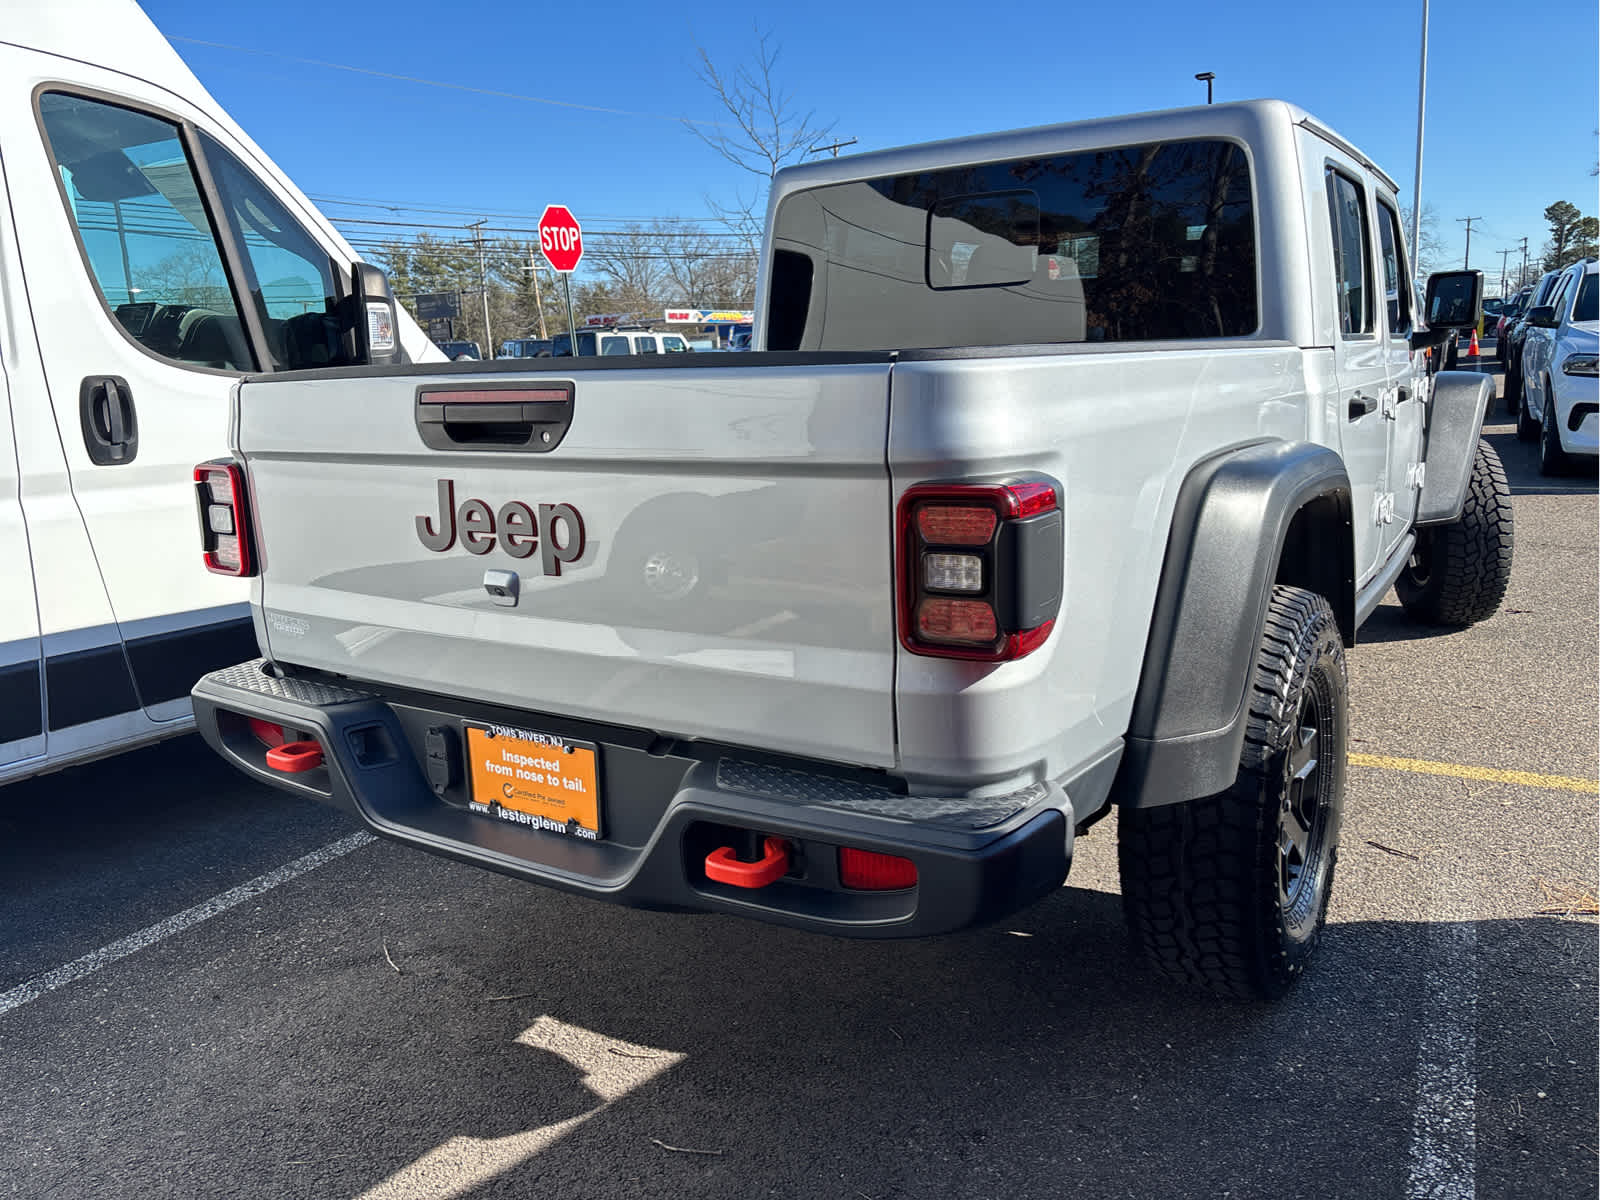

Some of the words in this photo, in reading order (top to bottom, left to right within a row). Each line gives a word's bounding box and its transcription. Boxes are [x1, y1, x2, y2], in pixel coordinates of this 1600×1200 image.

[542, 226, 579, 251] STOP
[415, 479, 586, 577] Jeep
[490, 725, 517, 739] TOMS
[550, 737, 564, 747] NJ
[502, 748, 560, 773] Inspected
[485, 760, 513, 777] from
[516, 769, 545, 784] nose
[547, 773, 560, 787] to
[562, 777, 587, 793] tail.
[468, 801, 490, 814] www.
[497, 806, 567, 834] lesterglenn
[574, 827, 597, 841] .com
